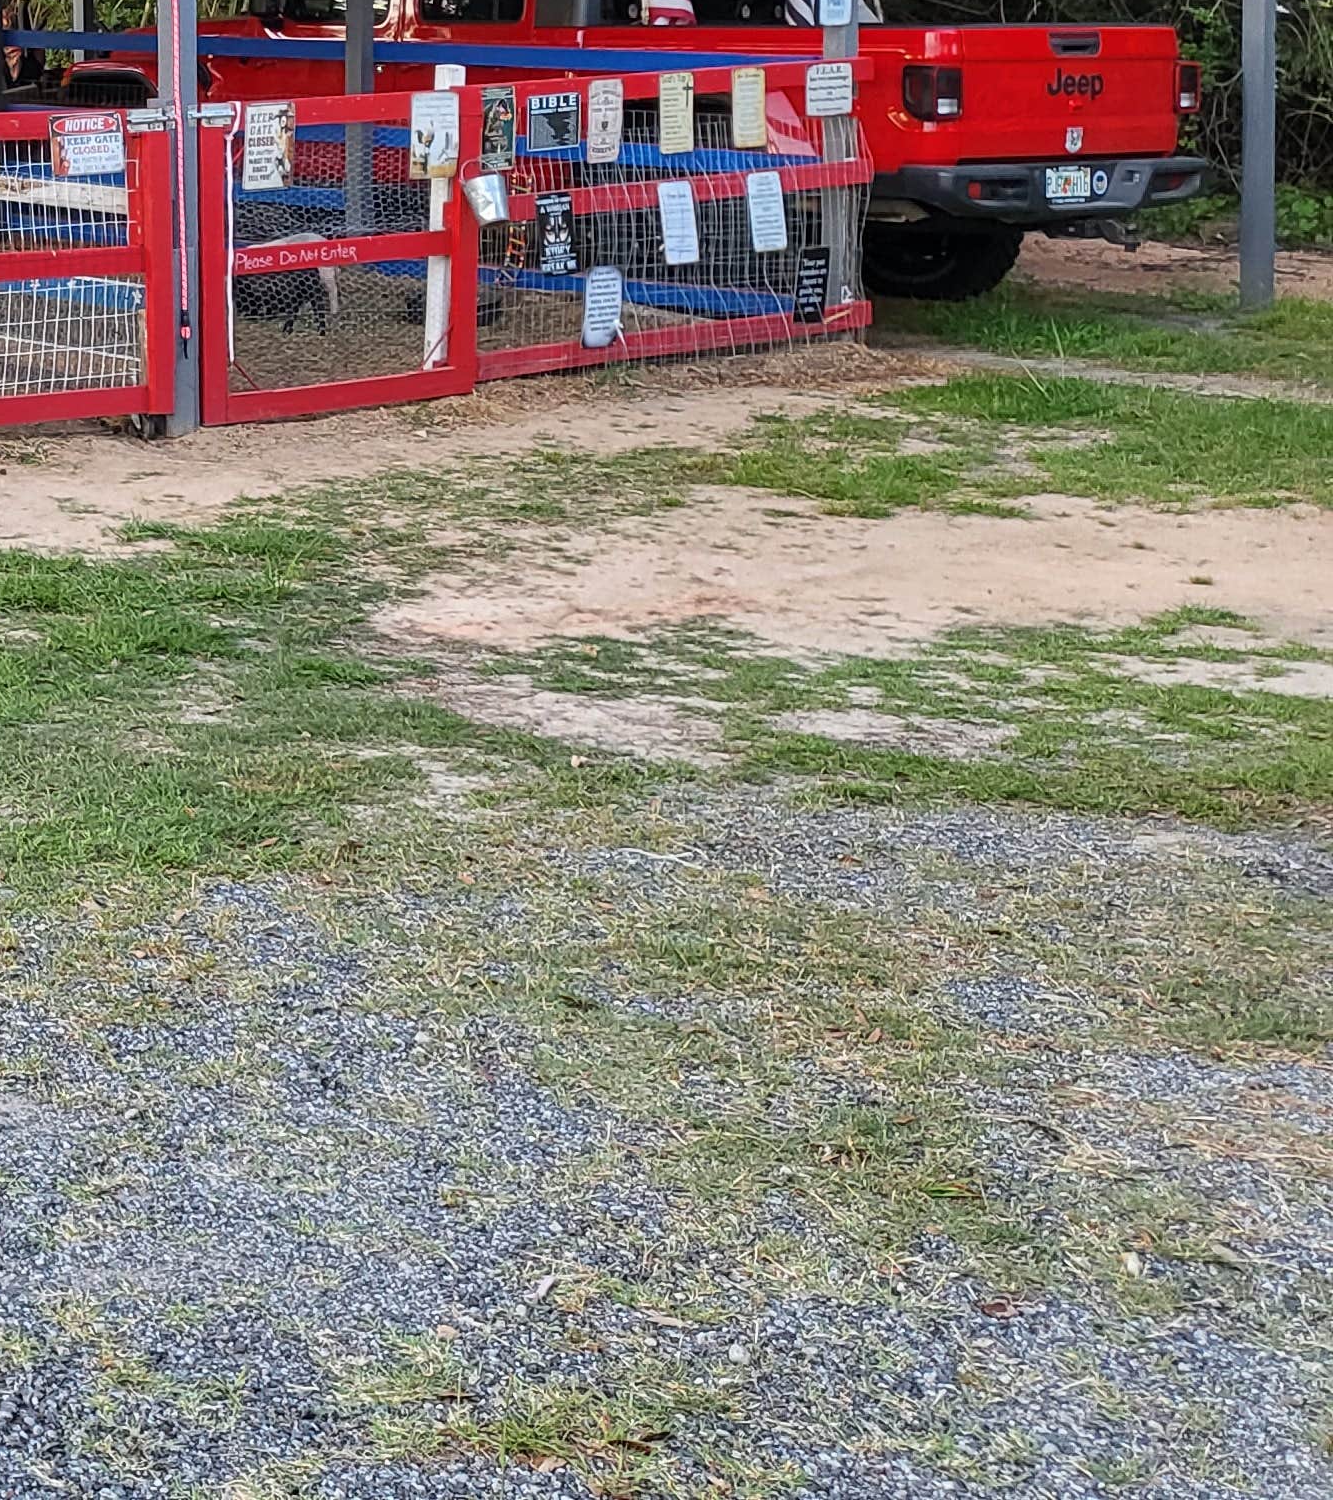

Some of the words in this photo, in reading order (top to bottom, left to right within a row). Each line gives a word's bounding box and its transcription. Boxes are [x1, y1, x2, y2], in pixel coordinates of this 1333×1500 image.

[1047, 68, 1104, 100] Jeep
[532, 95, 577, 109] BIBLE
[250, 113, 274, 123] KEEP
[65, 118, 104, 132] NOTICE
[250, 125, 273, 135] GATE
[67, 137, 91, 146] KEEP
[95, 135, 120, 144] GATE
[249, 136, 275, 148] CLOSED
[73, 145, 110, 155] CLOSED
[235, 253, 273, 271] Please
[279, 251, 297, 265] Do
